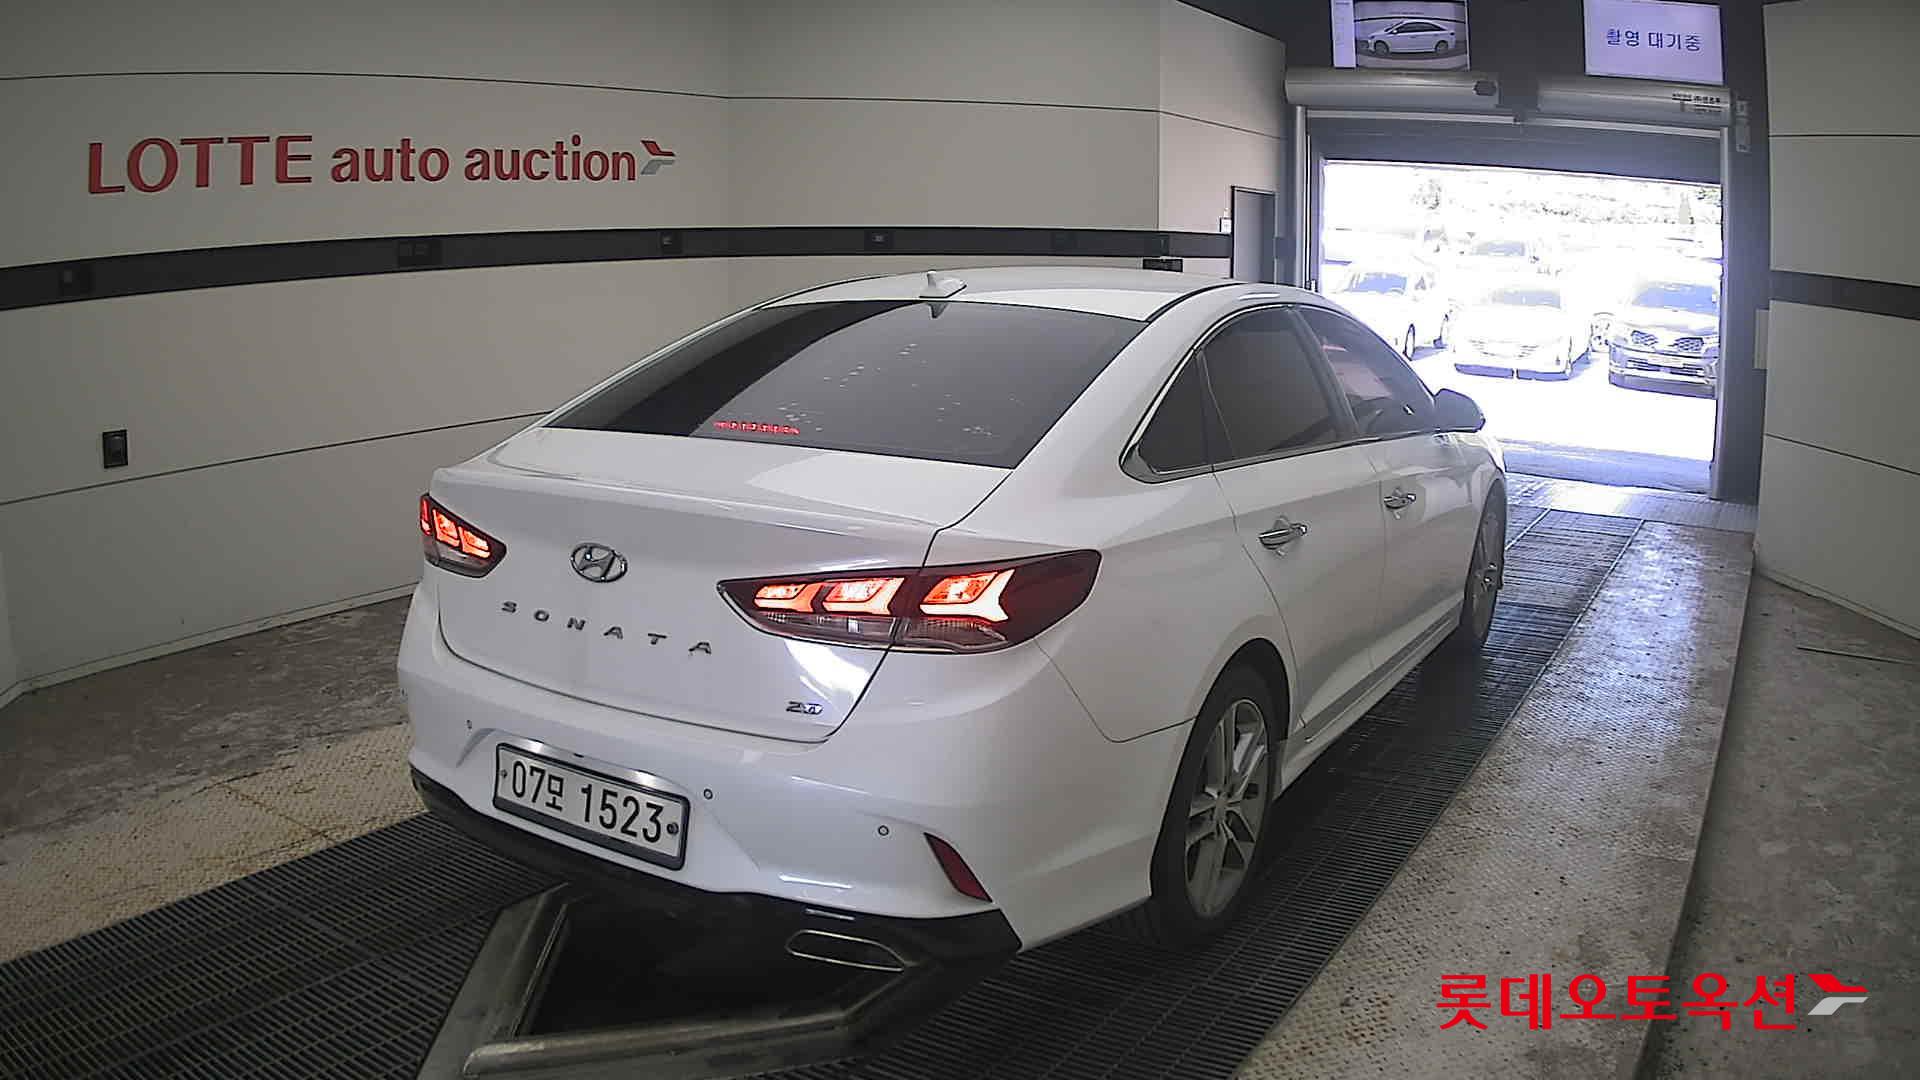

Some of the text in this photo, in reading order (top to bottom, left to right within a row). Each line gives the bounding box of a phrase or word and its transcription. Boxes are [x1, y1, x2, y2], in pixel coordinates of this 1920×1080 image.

[1648, 32, 1700, 51] 대기중
[88, 134, 637, 194] LOTTE auto auction
[501, 600, 712, 656] SONATA
[581, 784, 662, 843] 1523
